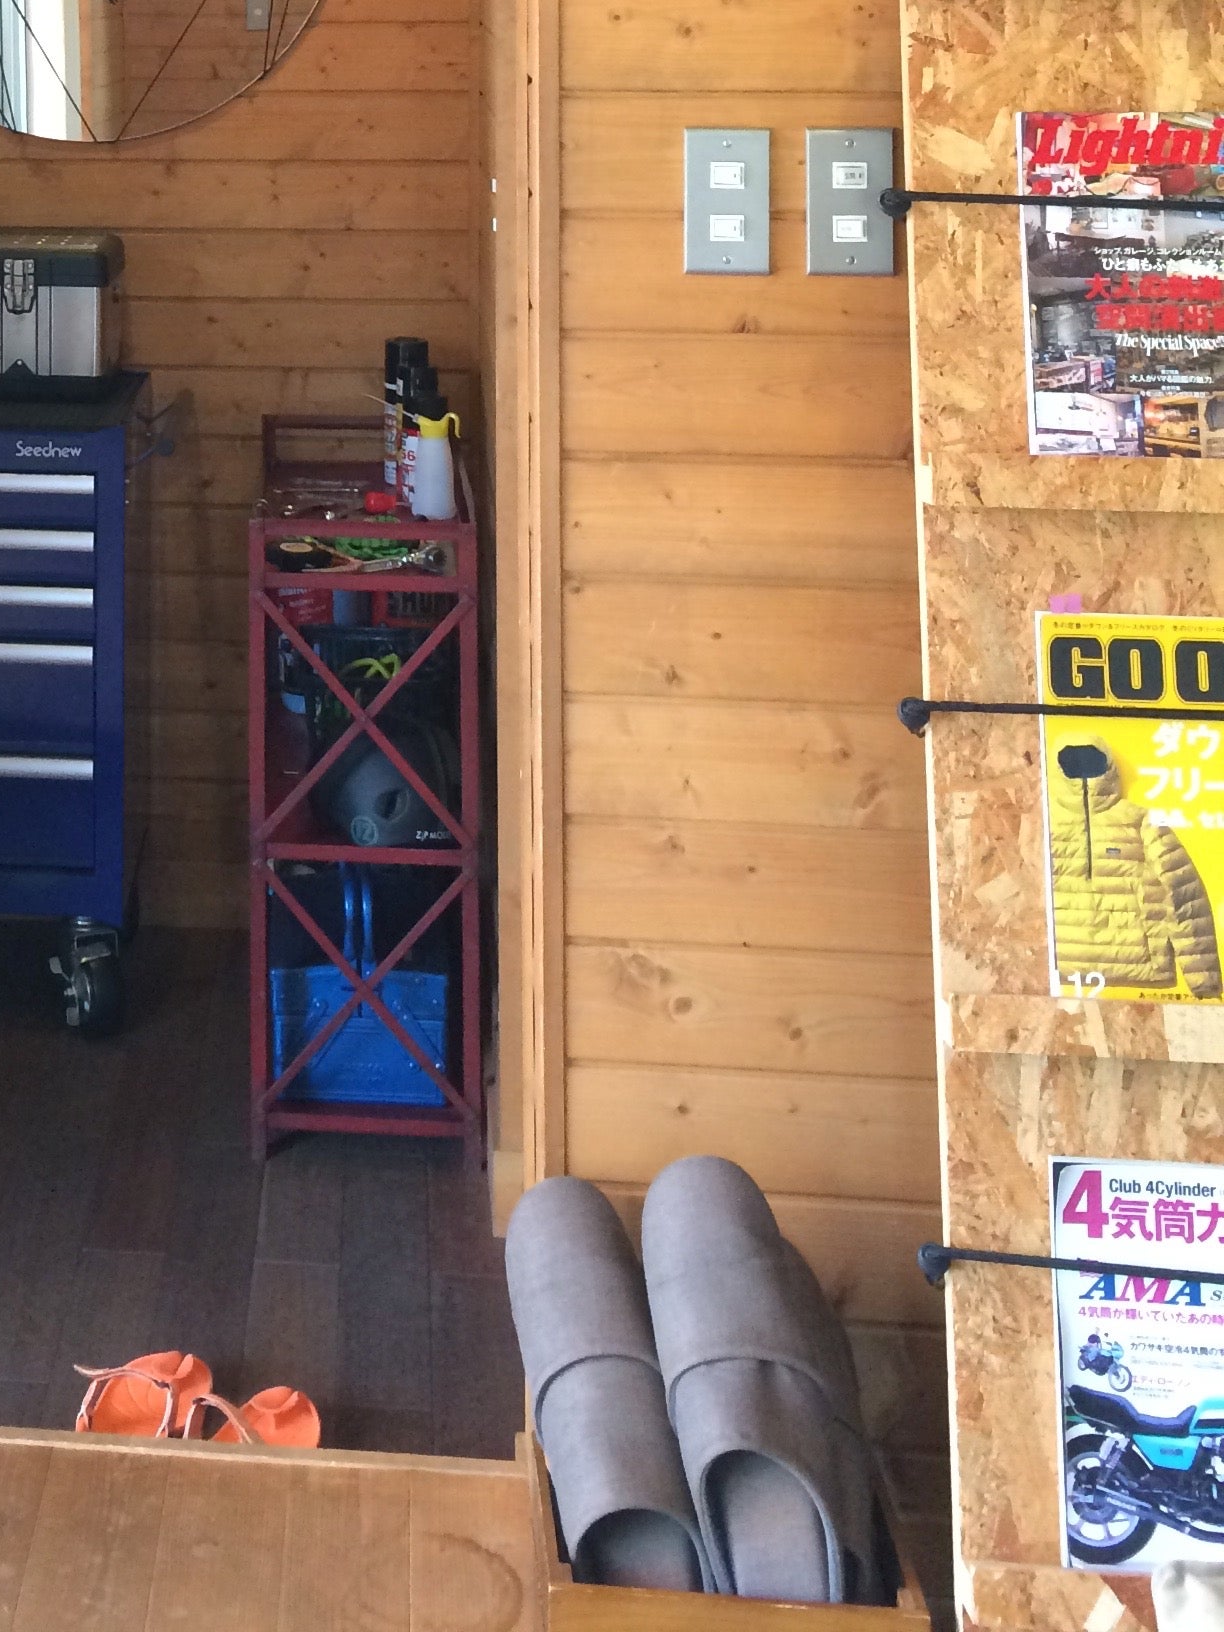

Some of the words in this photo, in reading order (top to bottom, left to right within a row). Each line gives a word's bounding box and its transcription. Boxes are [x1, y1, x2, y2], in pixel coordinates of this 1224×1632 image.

[1115, 334, 1139, 348] The
[16, 440, 82, 458] Seednew
[1109, 1178, 1142, 1194] Club
[1145, 1180, 1217, 1199] 4Cylinder
[1078, 1273, 1207, 1307] AMA
